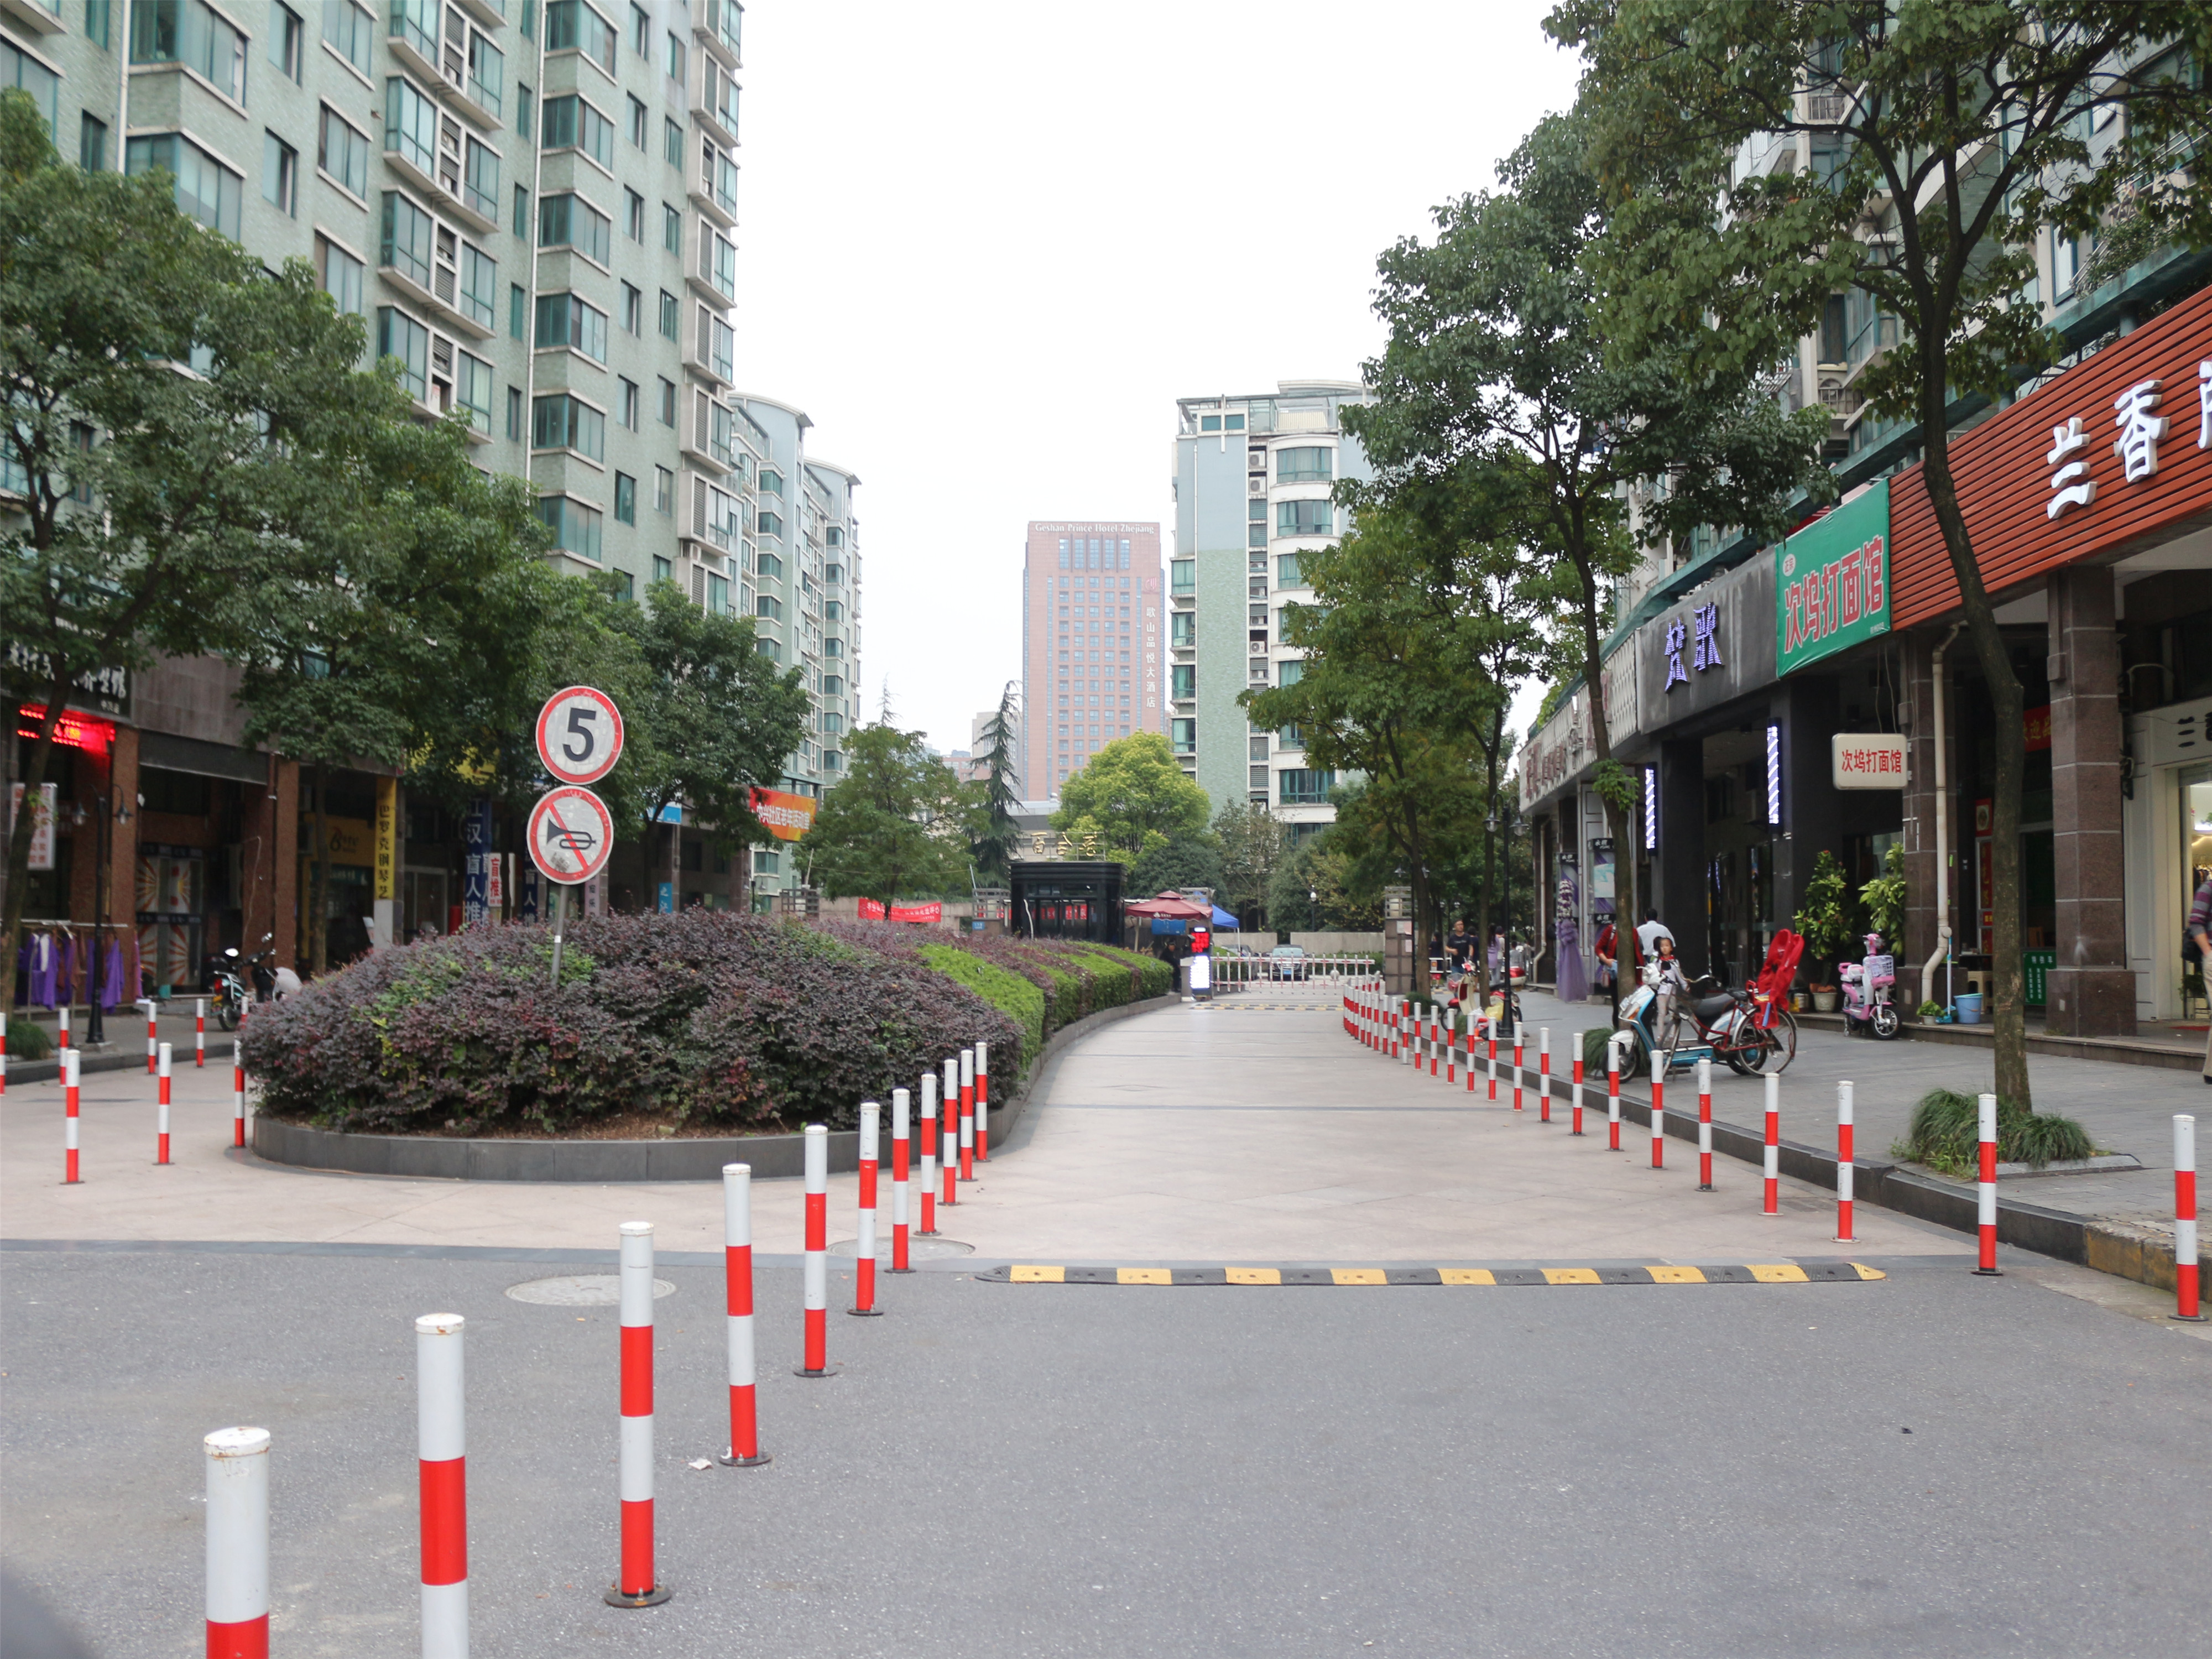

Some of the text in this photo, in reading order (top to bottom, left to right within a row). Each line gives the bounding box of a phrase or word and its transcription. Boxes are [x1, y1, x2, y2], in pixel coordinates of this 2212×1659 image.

[1035, 523, 1154, 534] Geshan Prince Hotel Zhejiang
[1785, 534, 1884, 654] 次坞打面馆
[1146, 607, 1156, 708] 歌山品悦大酒店
[562, 707, 596, 761] 5
[1841, 749, 1902, 773] 次坞打面馆
